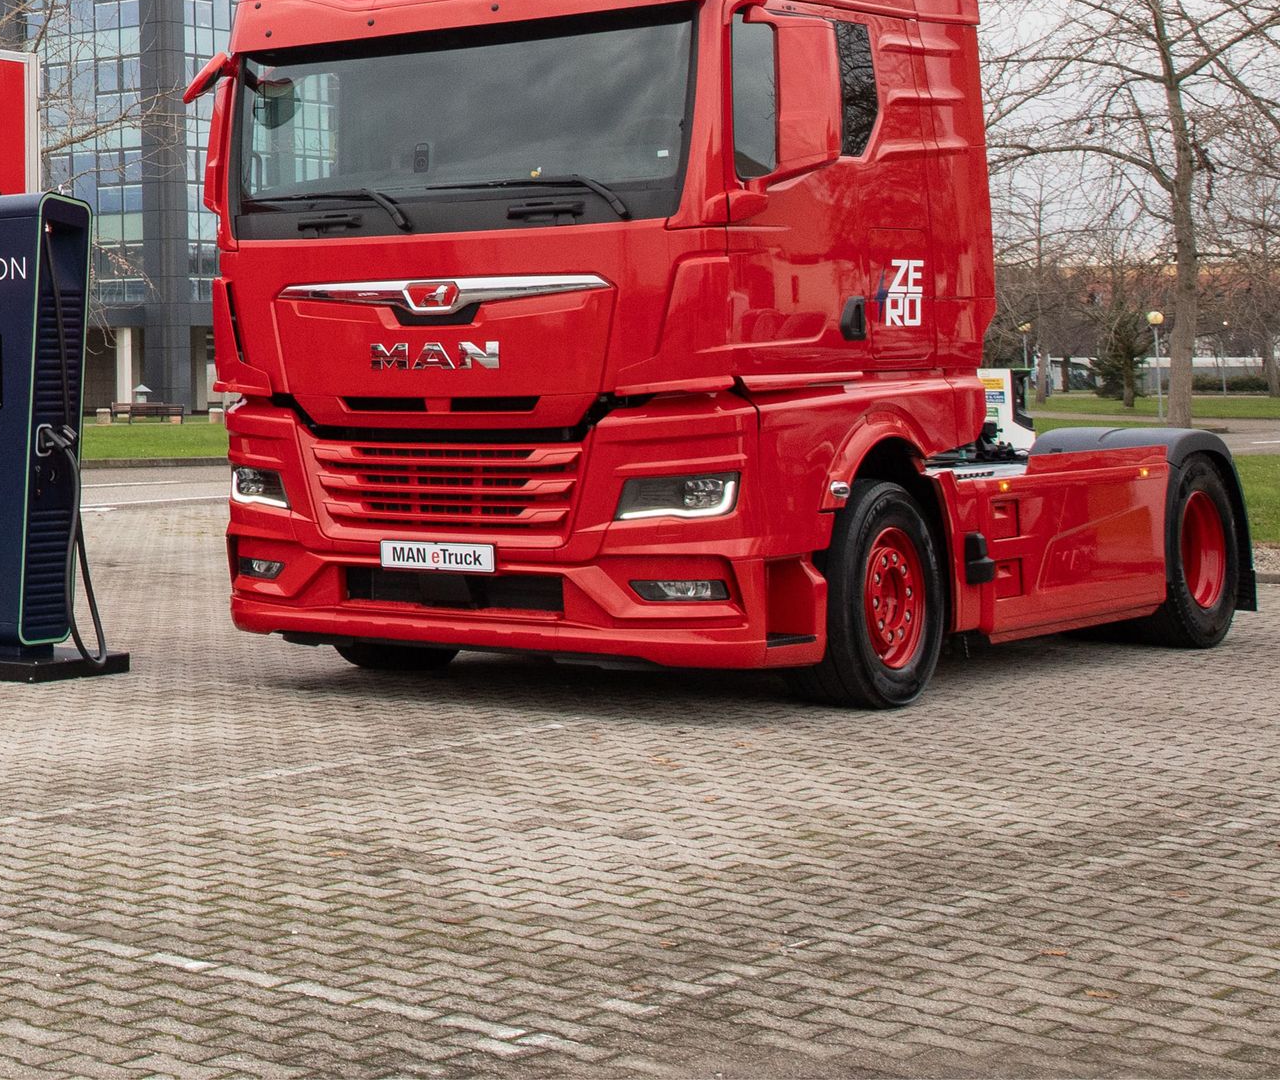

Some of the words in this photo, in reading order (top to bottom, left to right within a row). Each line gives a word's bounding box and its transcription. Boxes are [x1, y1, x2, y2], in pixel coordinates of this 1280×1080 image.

[369, 340, 500, 370] MAN
[392, 546, 427, 563] MAN
[431, 548, 483, 566] eTruck
